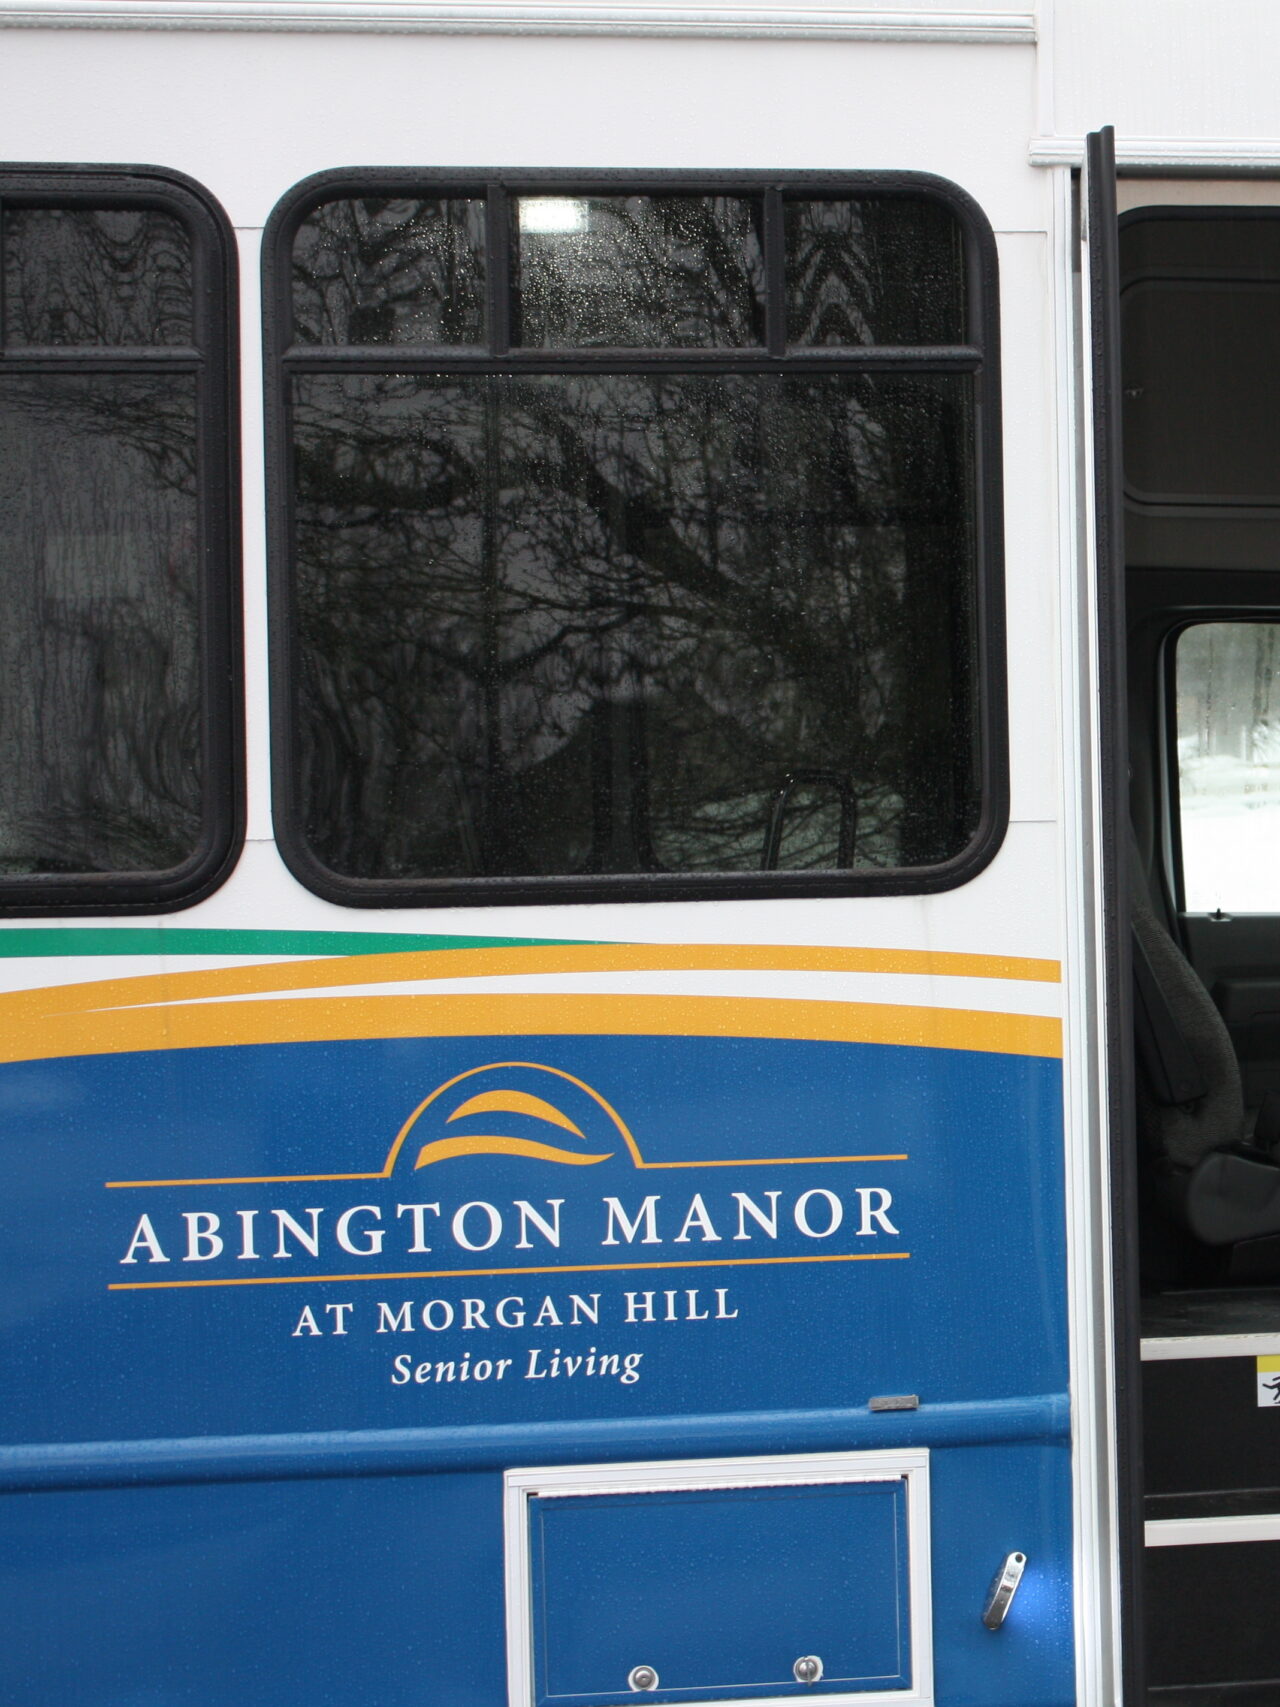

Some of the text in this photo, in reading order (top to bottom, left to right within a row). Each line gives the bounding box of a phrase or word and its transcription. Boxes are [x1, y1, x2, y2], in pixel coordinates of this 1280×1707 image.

[119, 1186, 901, 1265] ABINGTON MANOR
[292, 1288, 740, 1337] AT MORGAN HILL
[391, 1348, 643, 1386] Senior Living
